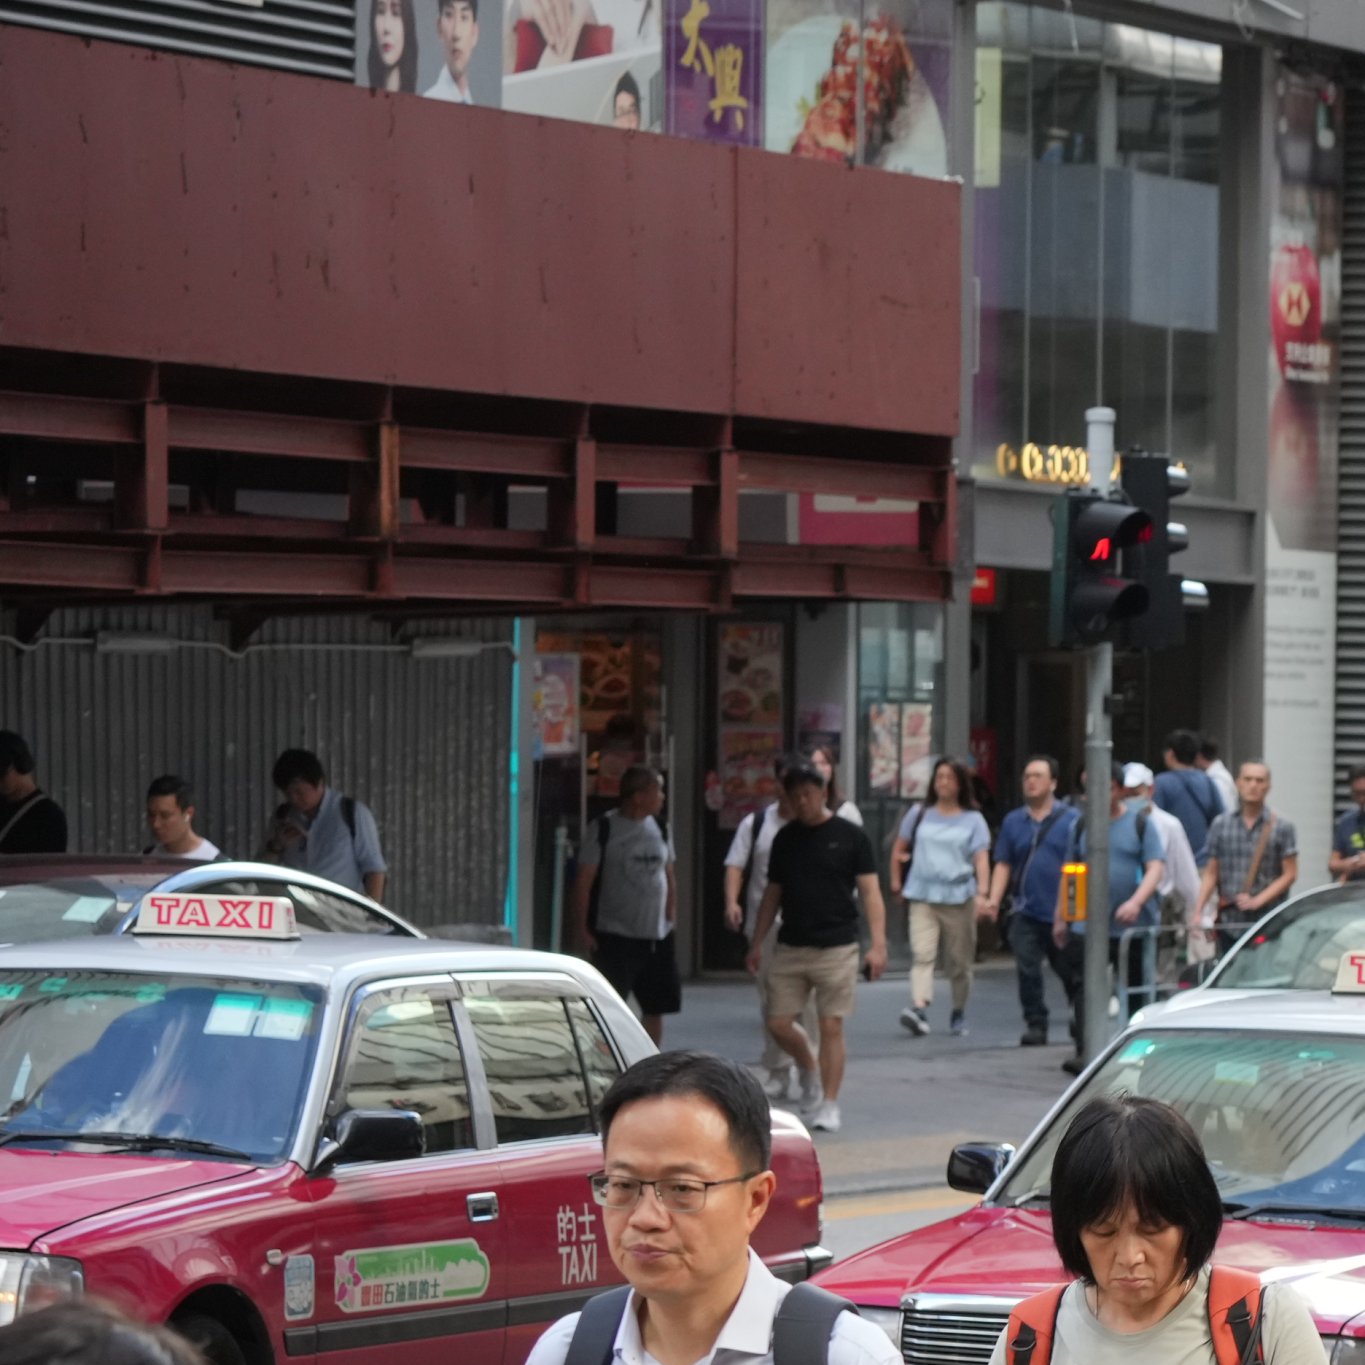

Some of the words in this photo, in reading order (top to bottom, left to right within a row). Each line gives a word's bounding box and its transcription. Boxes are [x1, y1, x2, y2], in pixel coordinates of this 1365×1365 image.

[681, 0, 748, 132] 太興
[151, 898, 273, 929] TAXI
[557, 1203, 597, 1242] 的士
[558, 1243, 597, 1285] TAXI
